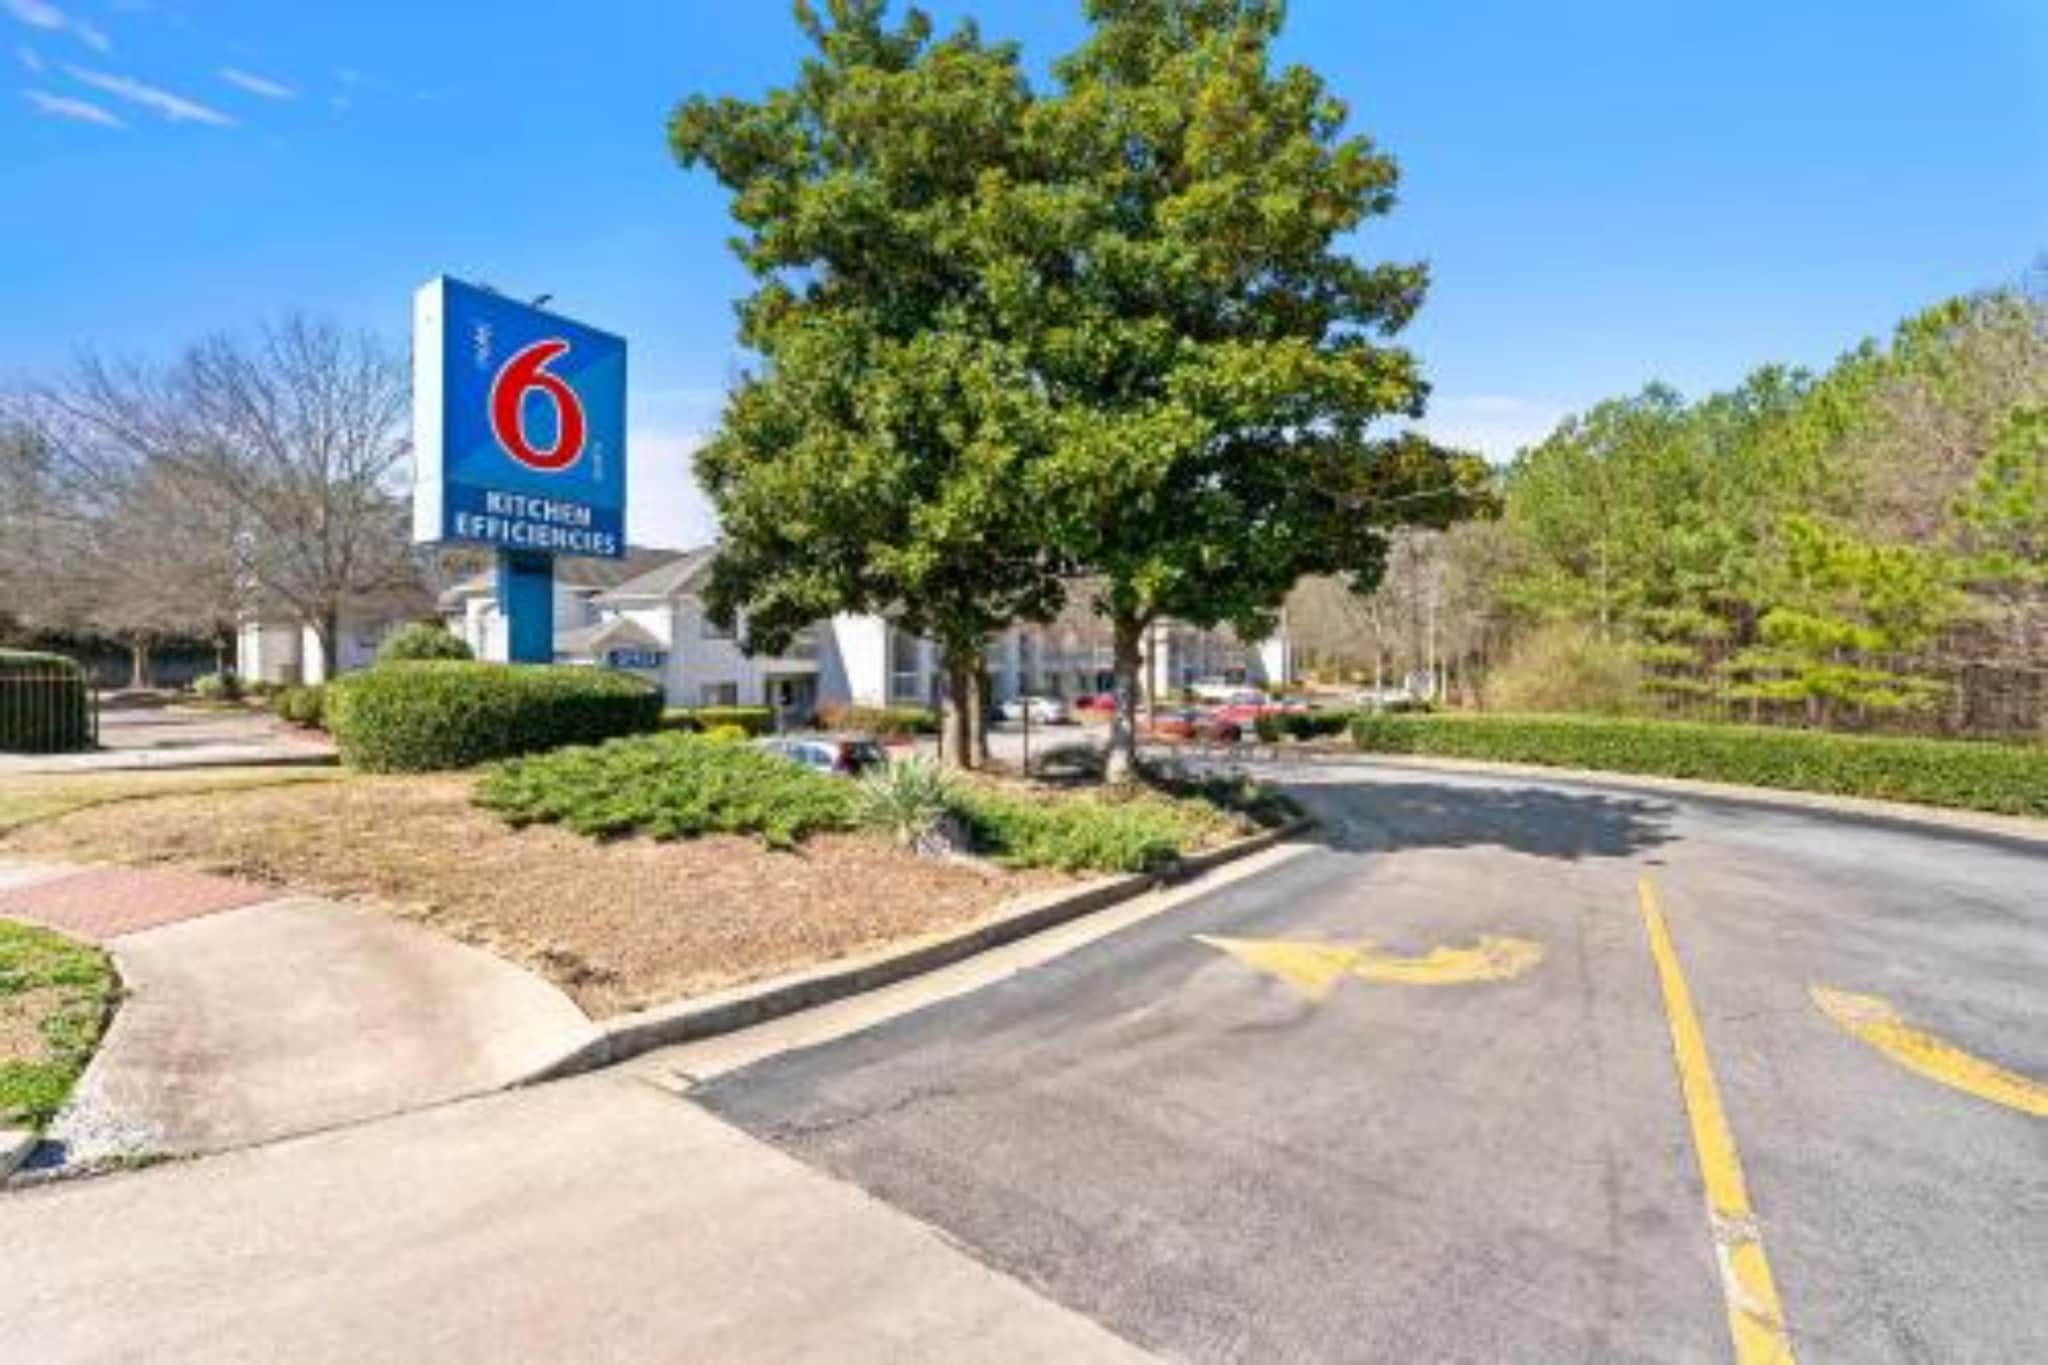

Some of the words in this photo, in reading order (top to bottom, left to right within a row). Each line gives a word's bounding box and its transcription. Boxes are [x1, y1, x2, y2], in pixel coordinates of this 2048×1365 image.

[489, 339, 587, 473] 6
[486, 491, 592, 526] KITCHEN
[455, 511, 616, 554] EFFICIENCIES
